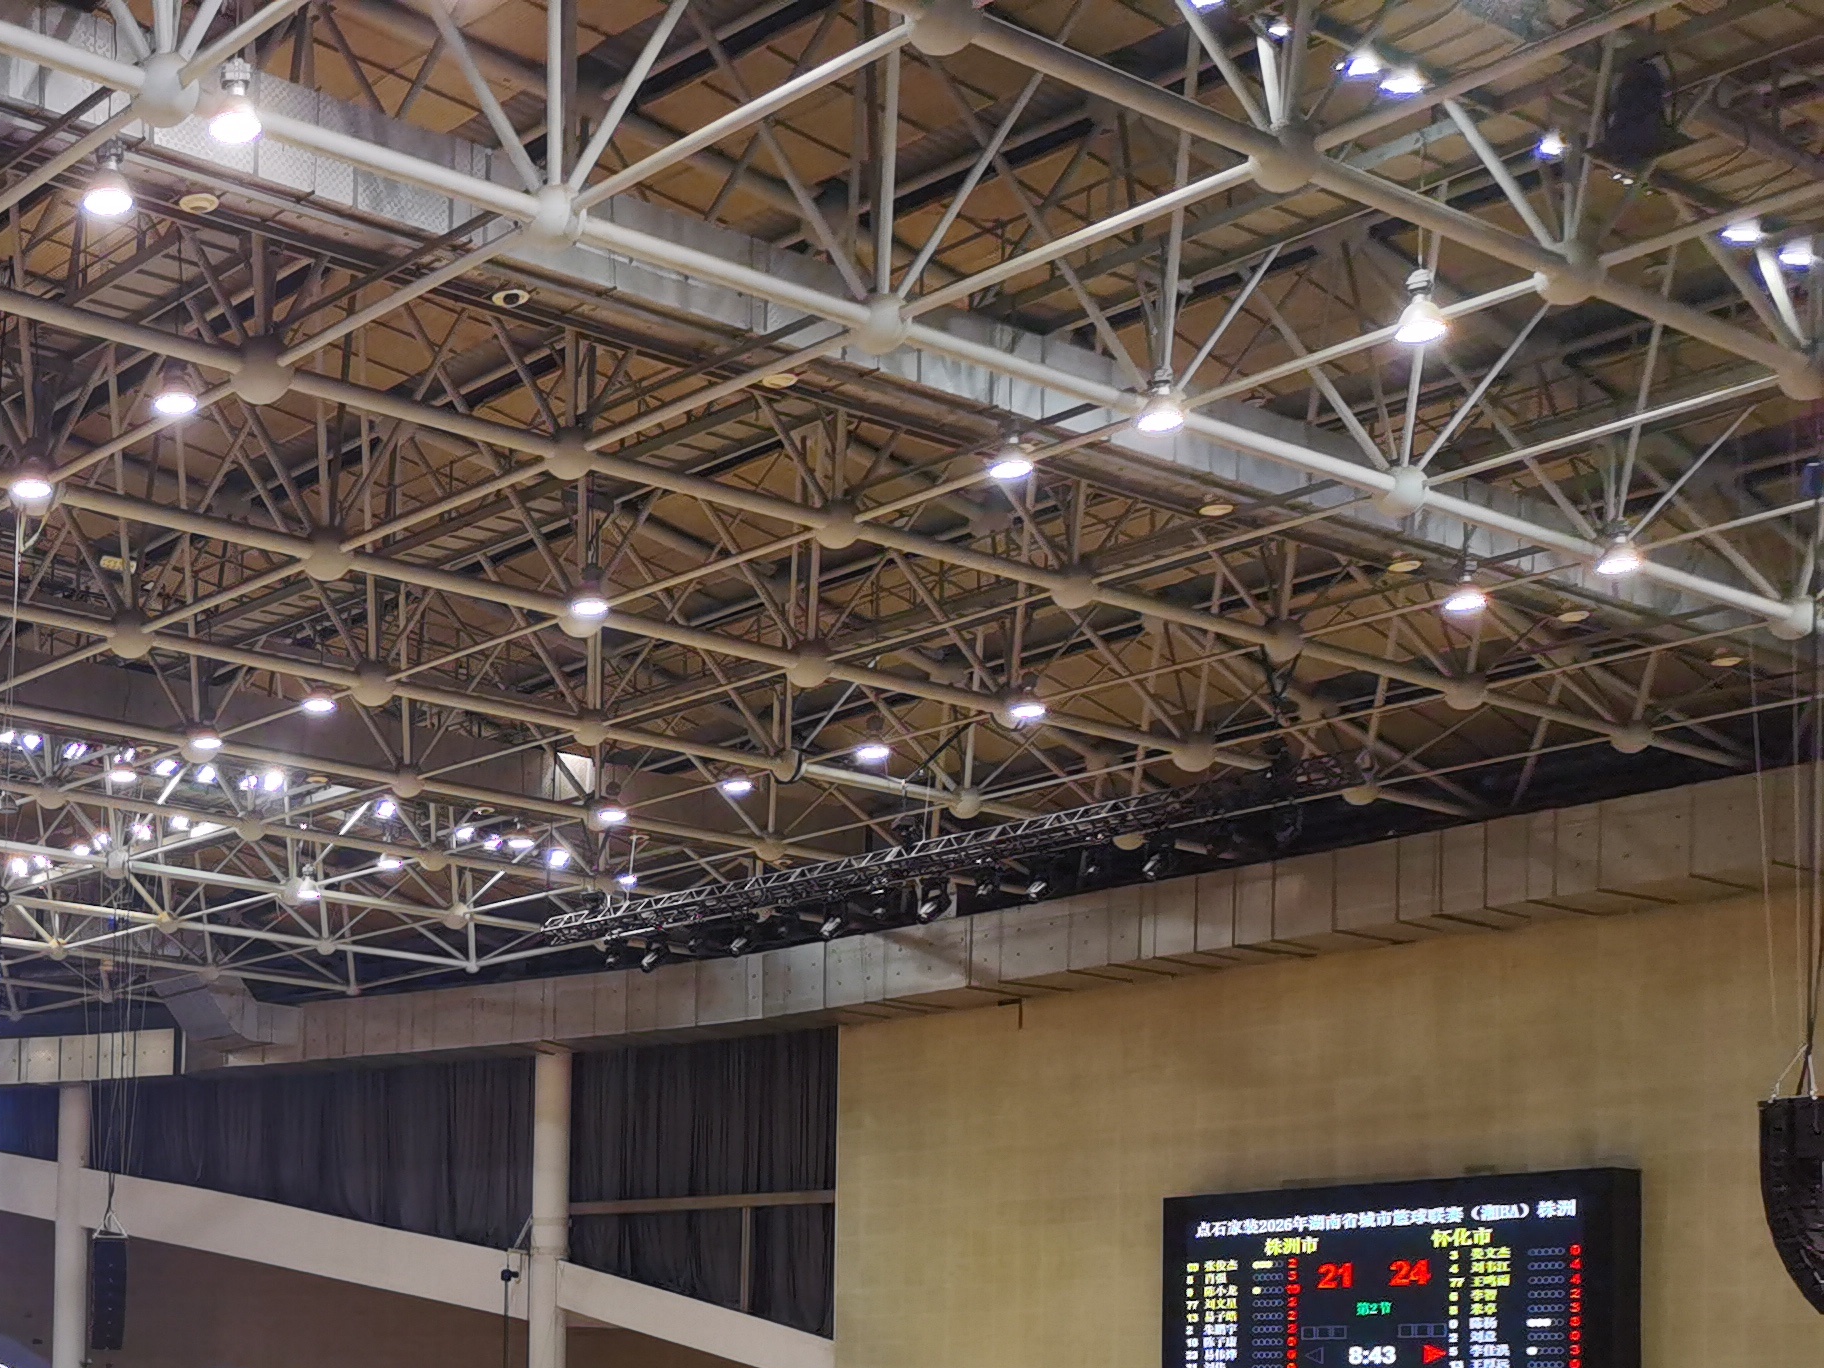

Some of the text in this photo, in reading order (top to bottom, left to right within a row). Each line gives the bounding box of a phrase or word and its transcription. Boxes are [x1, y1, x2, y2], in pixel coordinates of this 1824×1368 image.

[1430, 1227, 1494, 1248] 怀化市
[1264, 1236, 1319, 1256] 株洲市
[1389, 1259, 1432, 1287] 24
[1449, 1258, 1582, 1273] 4 4
[1317, 1262, 1355, 1289] 21
[1449, 1277, 1465, 1288] 77
[1569, 1288, 1582, 1299] 2
[1186, 1297, 1298, 1311] 77 2
[1356, 1301, 1392, 1316] 第2节
[1287, 1310, 1298, 1321] 2
[1186, 1325, 1194, 1335] 2
[1449, 1333, 1458, 1343] 2
[1348, 1345, 1397, 1365] 8:43
